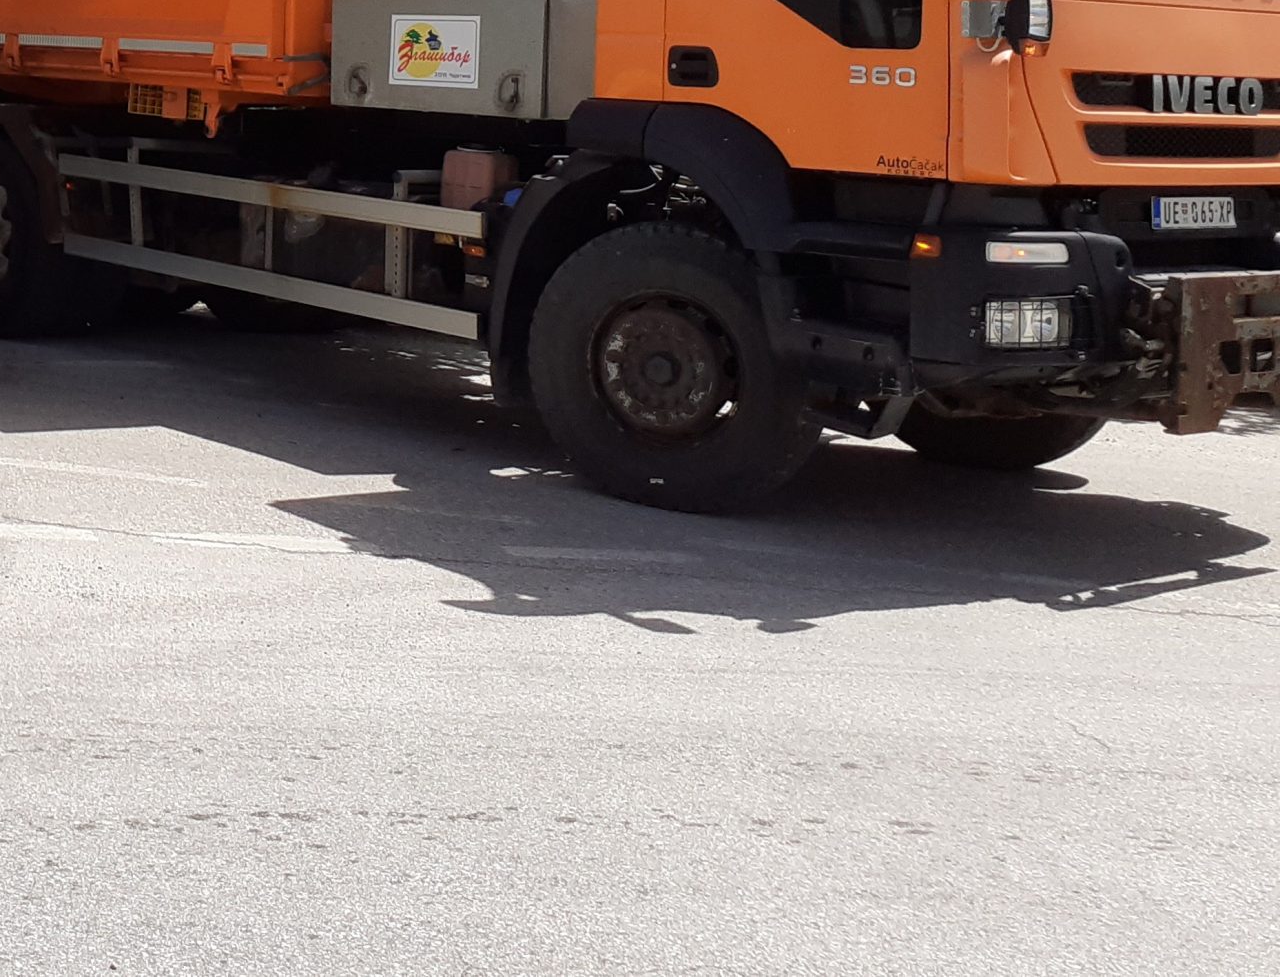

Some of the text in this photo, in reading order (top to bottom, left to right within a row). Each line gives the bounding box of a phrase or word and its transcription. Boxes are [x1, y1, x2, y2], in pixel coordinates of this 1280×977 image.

[848, 64, 917, 87] 360
[1152, 75, 1264, 115] IVECO
[1163, 201, 1180, 224] UE
